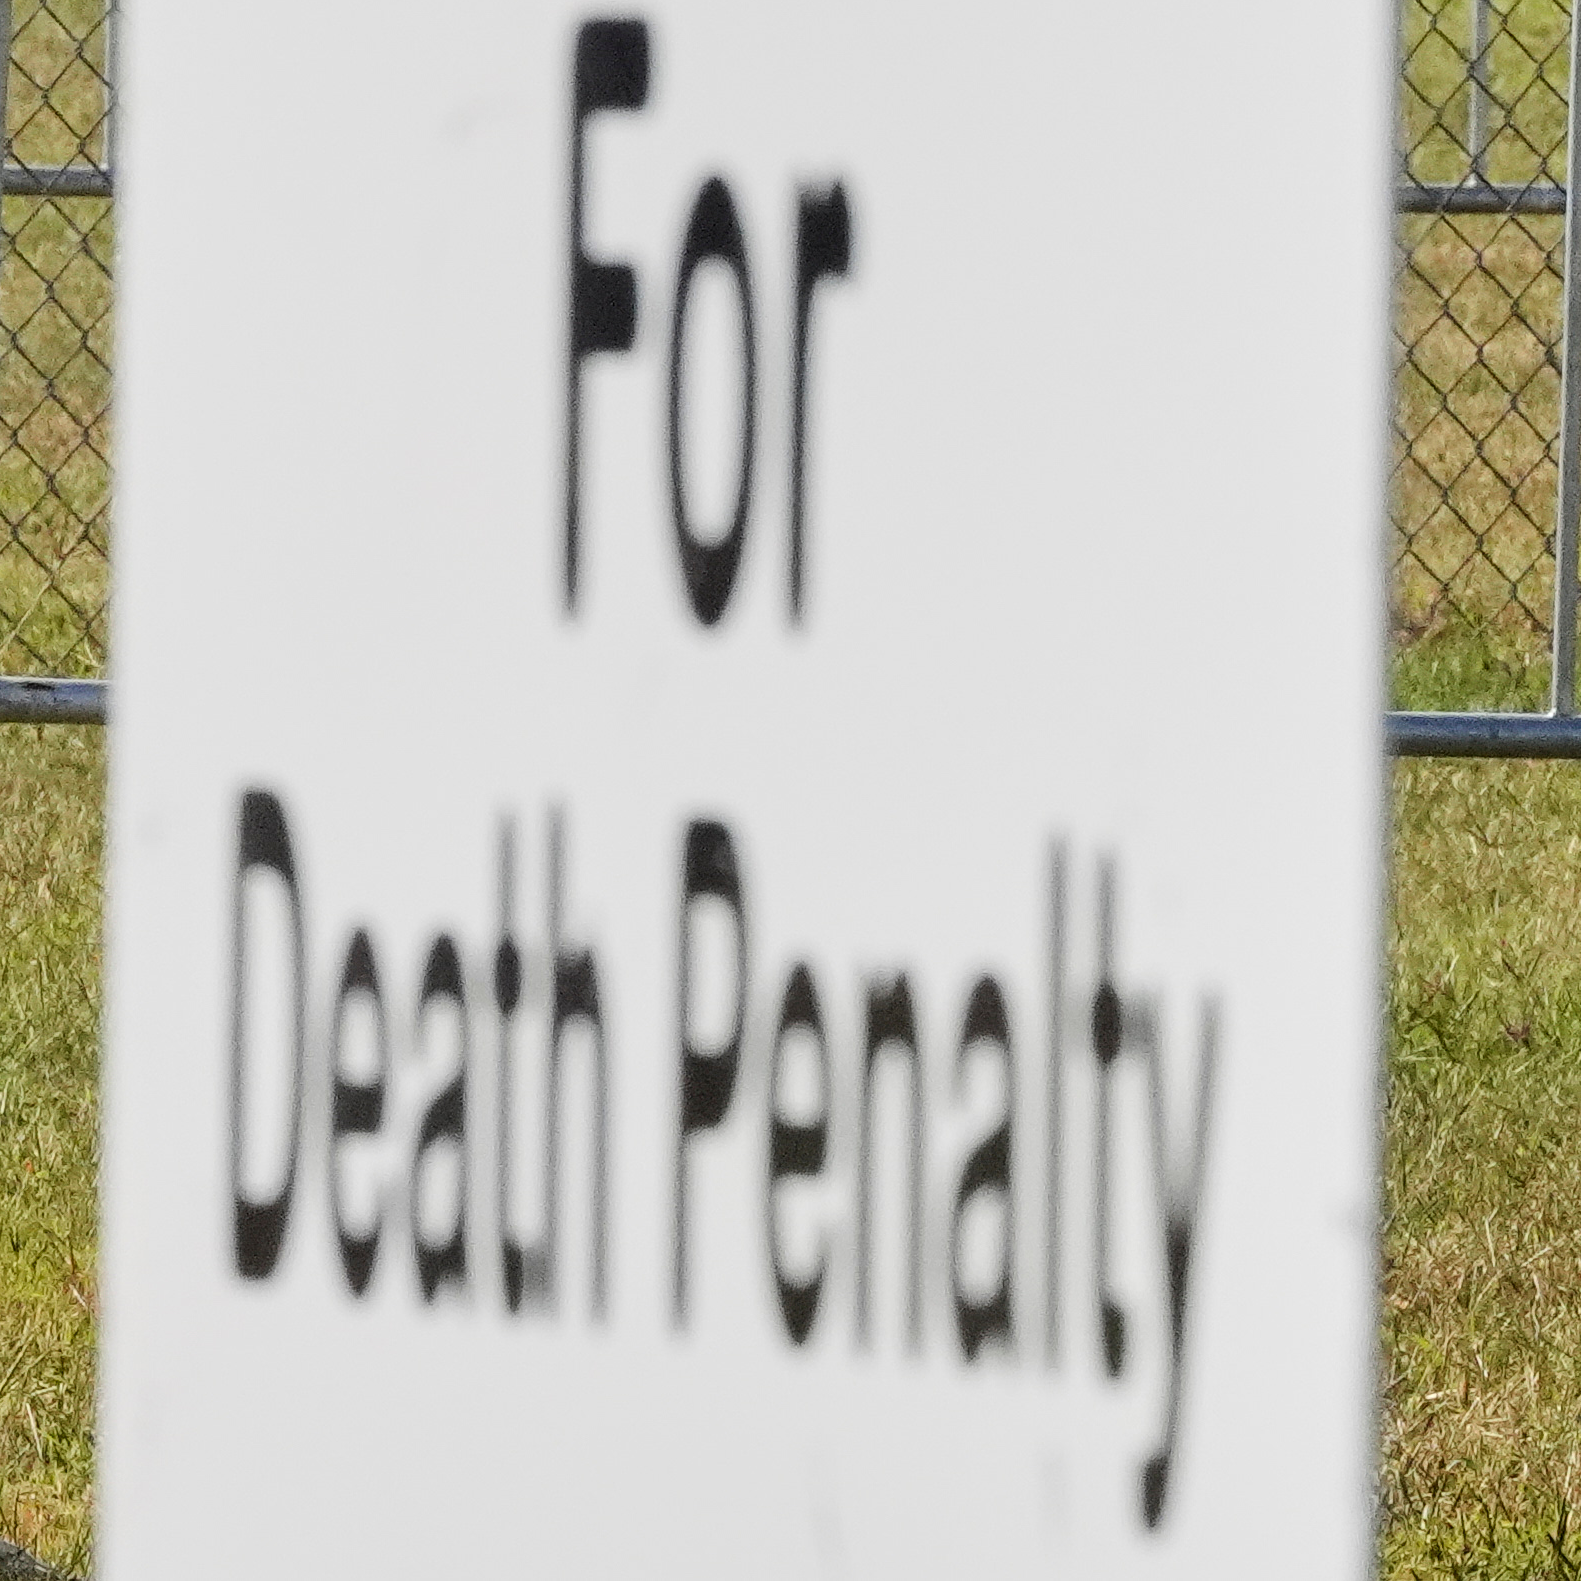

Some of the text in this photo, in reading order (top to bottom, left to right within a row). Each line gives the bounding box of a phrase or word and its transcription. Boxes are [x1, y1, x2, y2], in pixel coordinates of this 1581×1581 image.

[555, 15, 859, 630] For
[223, 786, 1227, 1532] Death Penalty
